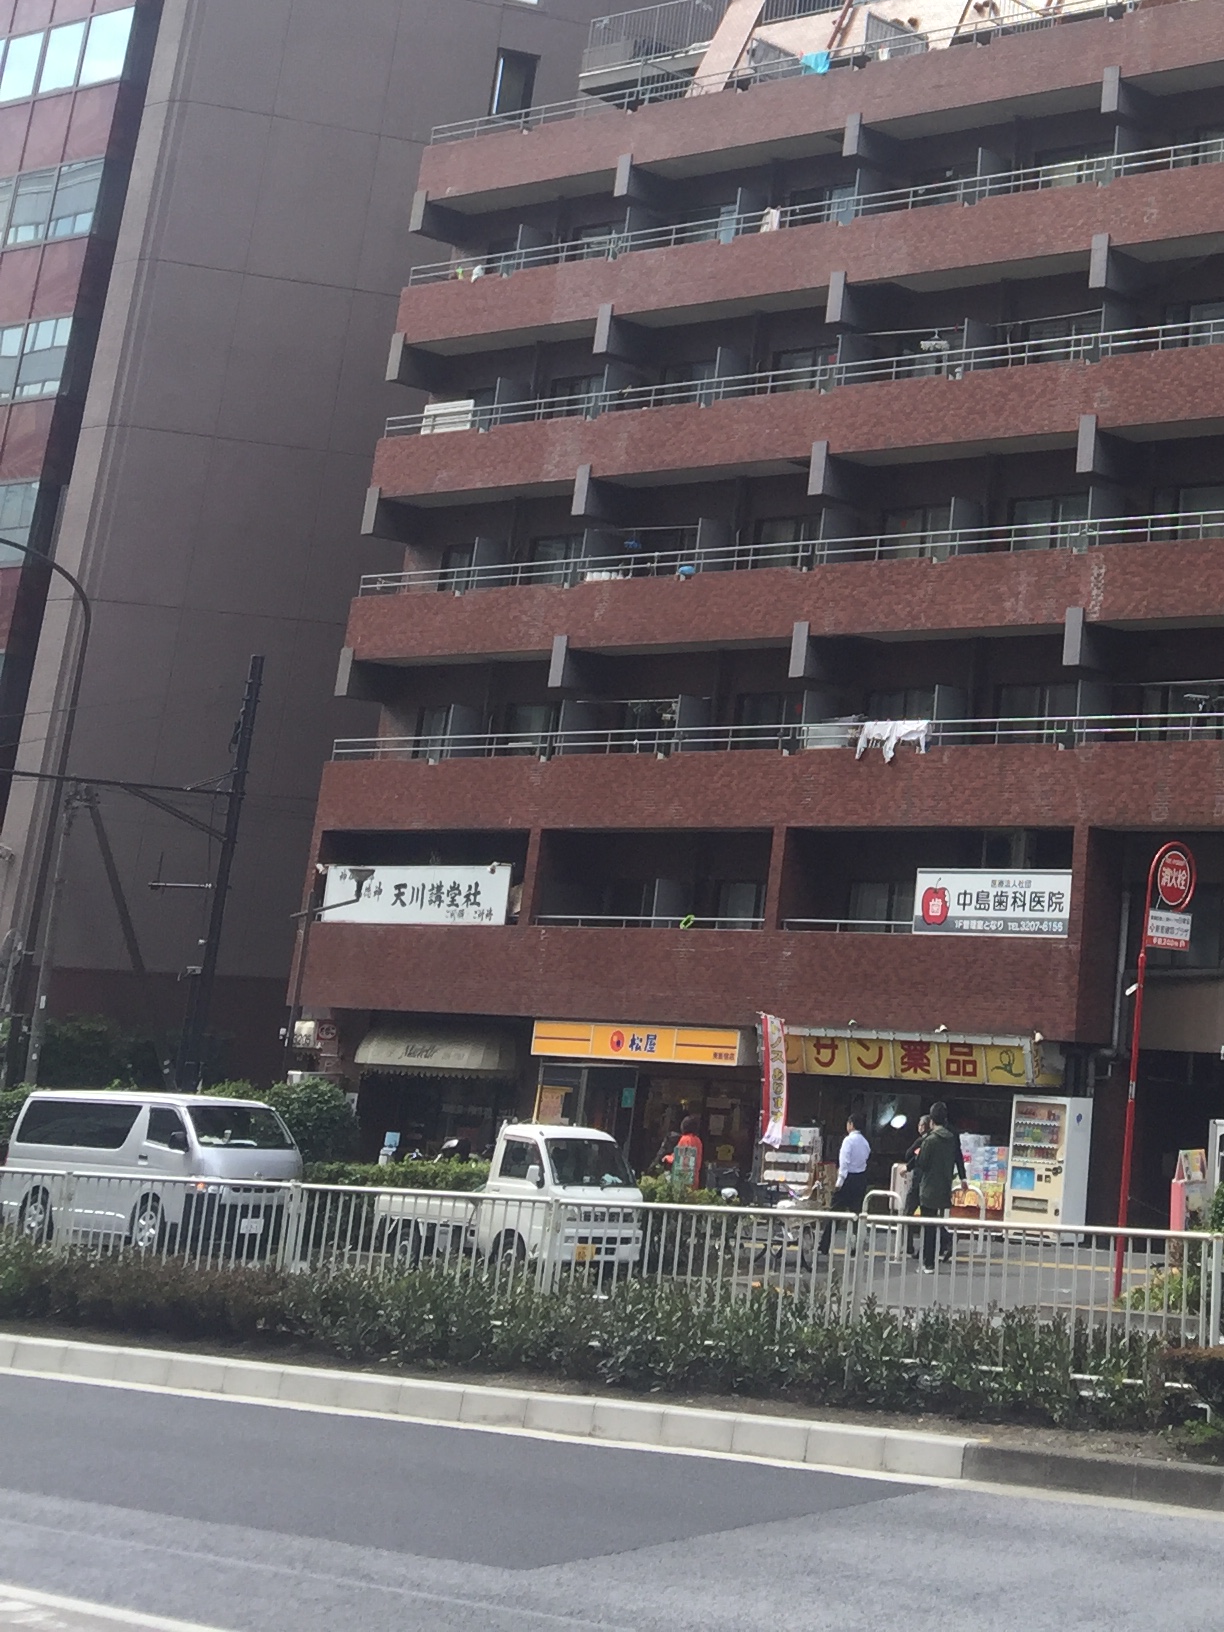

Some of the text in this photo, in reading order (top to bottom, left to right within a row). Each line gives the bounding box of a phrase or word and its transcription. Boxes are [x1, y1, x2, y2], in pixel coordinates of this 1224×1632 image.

[1160, 867, 1188, 890] 消火栓
[956, 889, 1065, 913] 中島歯科医院
[628, 1033, 658, 1053] 松屋
[812, 1036, 978, 1078] サン薬品
